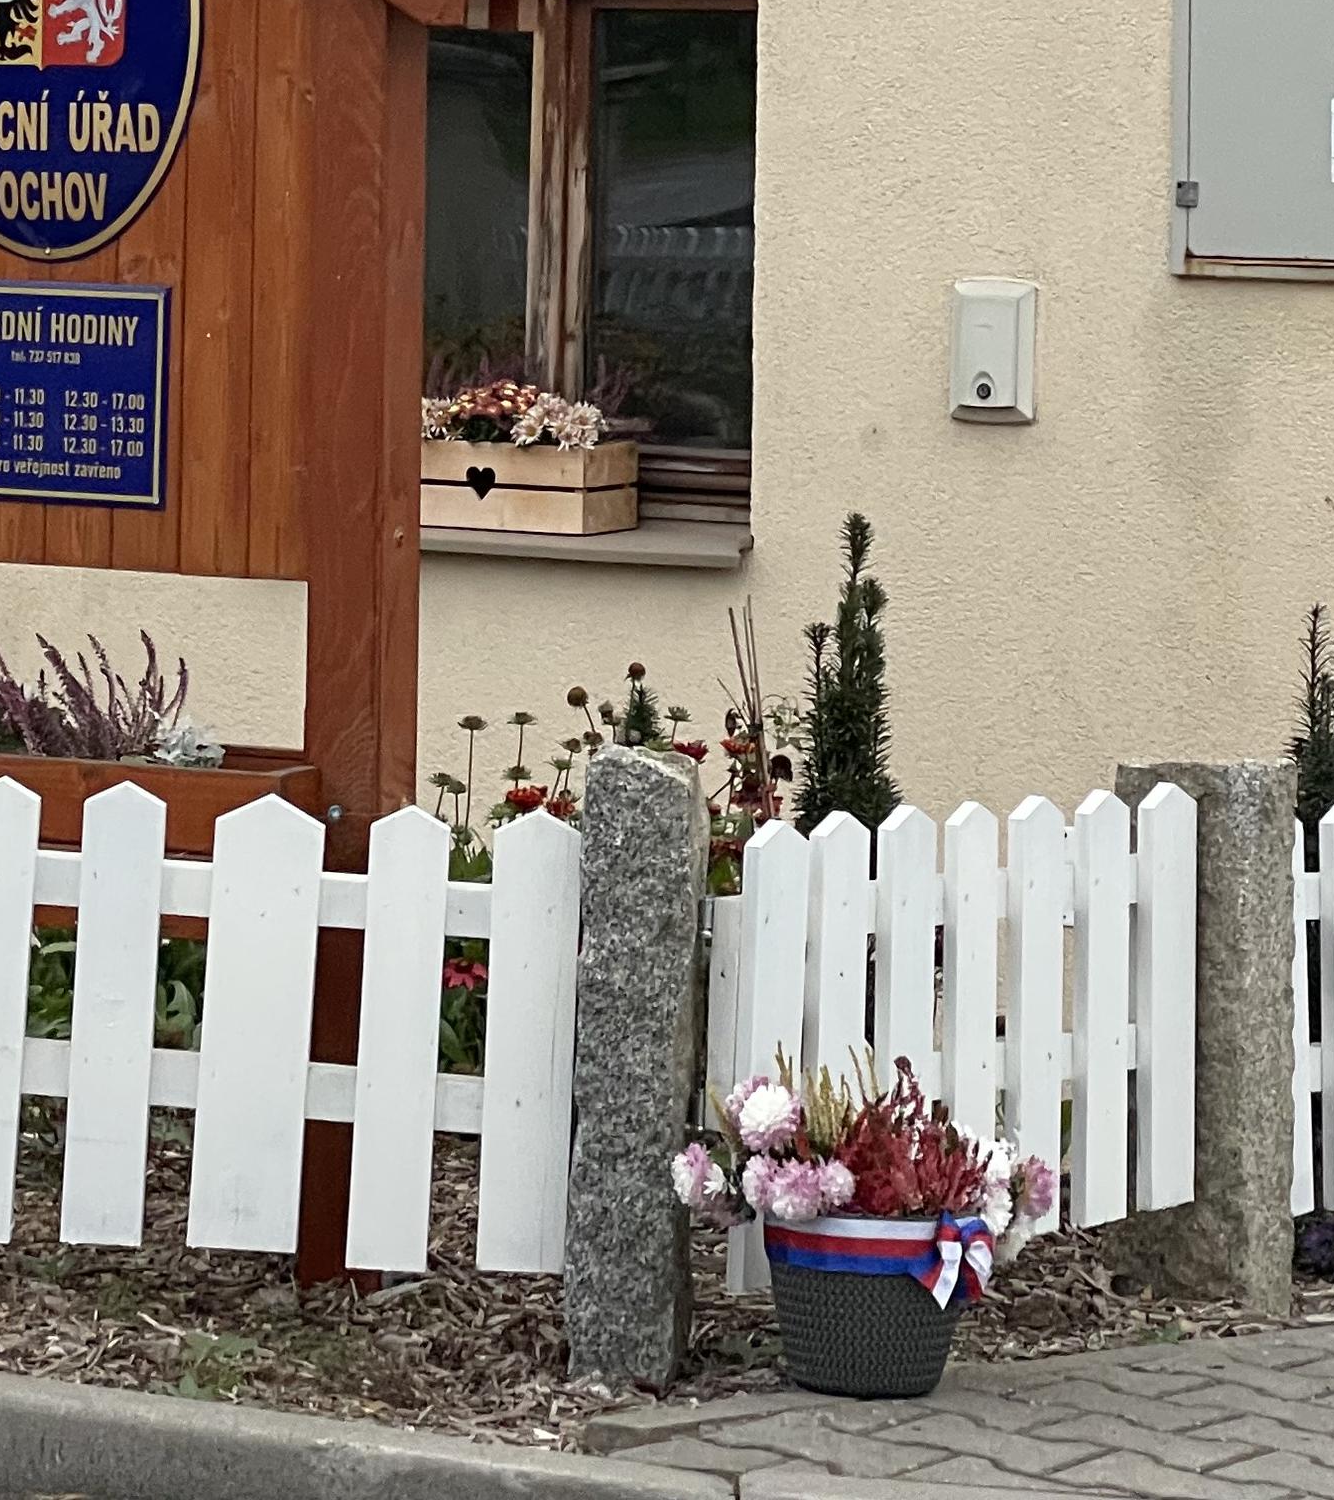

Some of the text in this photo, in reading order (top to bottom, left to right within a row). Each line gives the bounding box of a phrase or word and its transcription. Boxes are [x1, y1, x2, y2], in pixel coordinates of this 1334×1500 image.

[68, 89, 161, 153] ÚŘAD
[50, 312, 139, 346] HODINY
[14, 388, 45, 405] 11.30
[64, 390, 98, 408] 12.30
[111, 393, 145, 410] 17.00
[13, 411, 44, 428] 11.30
[63, 414, 98, 431] 12.30
[111, 416, 145, 433] 13.30
[12, 434, 43, 451] 11.30
[63, 437, 97, 454] 12.30
[110, 439, 144, 457] 17.00
[14, 458, 70, 478] veřejnost
